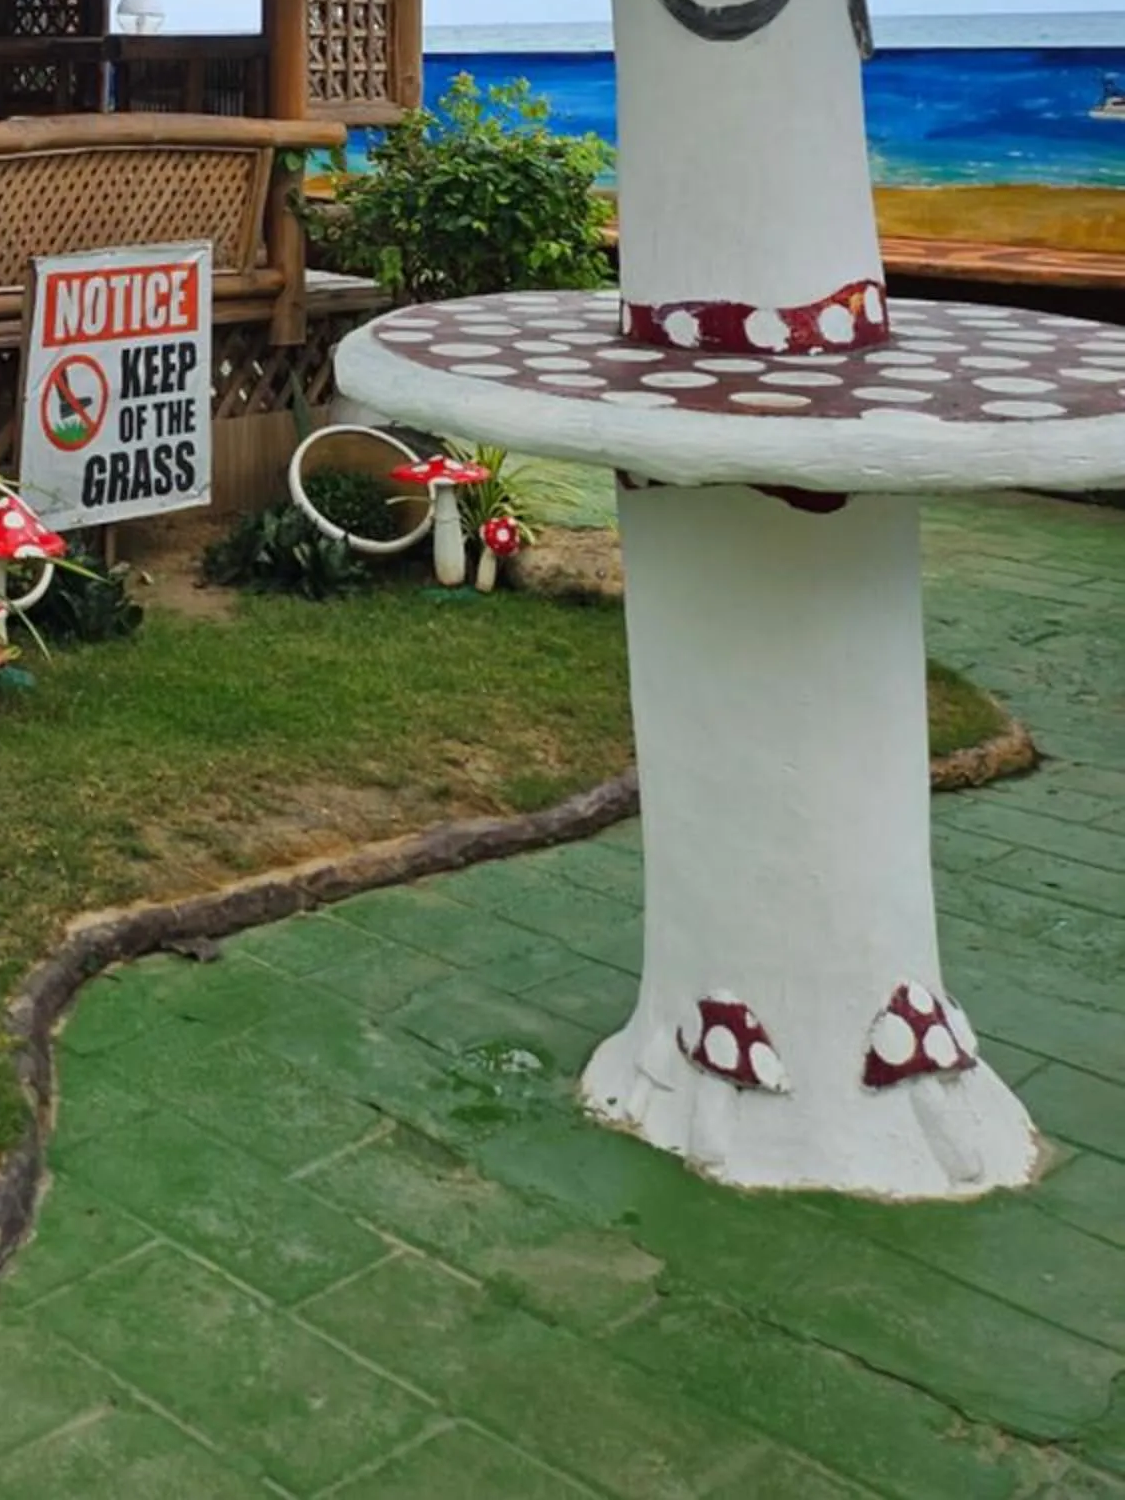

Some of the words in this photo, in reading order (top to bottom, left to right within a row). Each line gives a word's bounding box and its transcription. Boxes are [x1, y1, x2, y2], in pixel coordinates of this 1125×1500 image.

[54, 270, 188, 339] NOTICE
[119, 341, 196, 400] KEEP
[119, 403, 148, 443] OF
[153, 399, 196, 438] THE
[81, 440, 196, 508] GRASS
